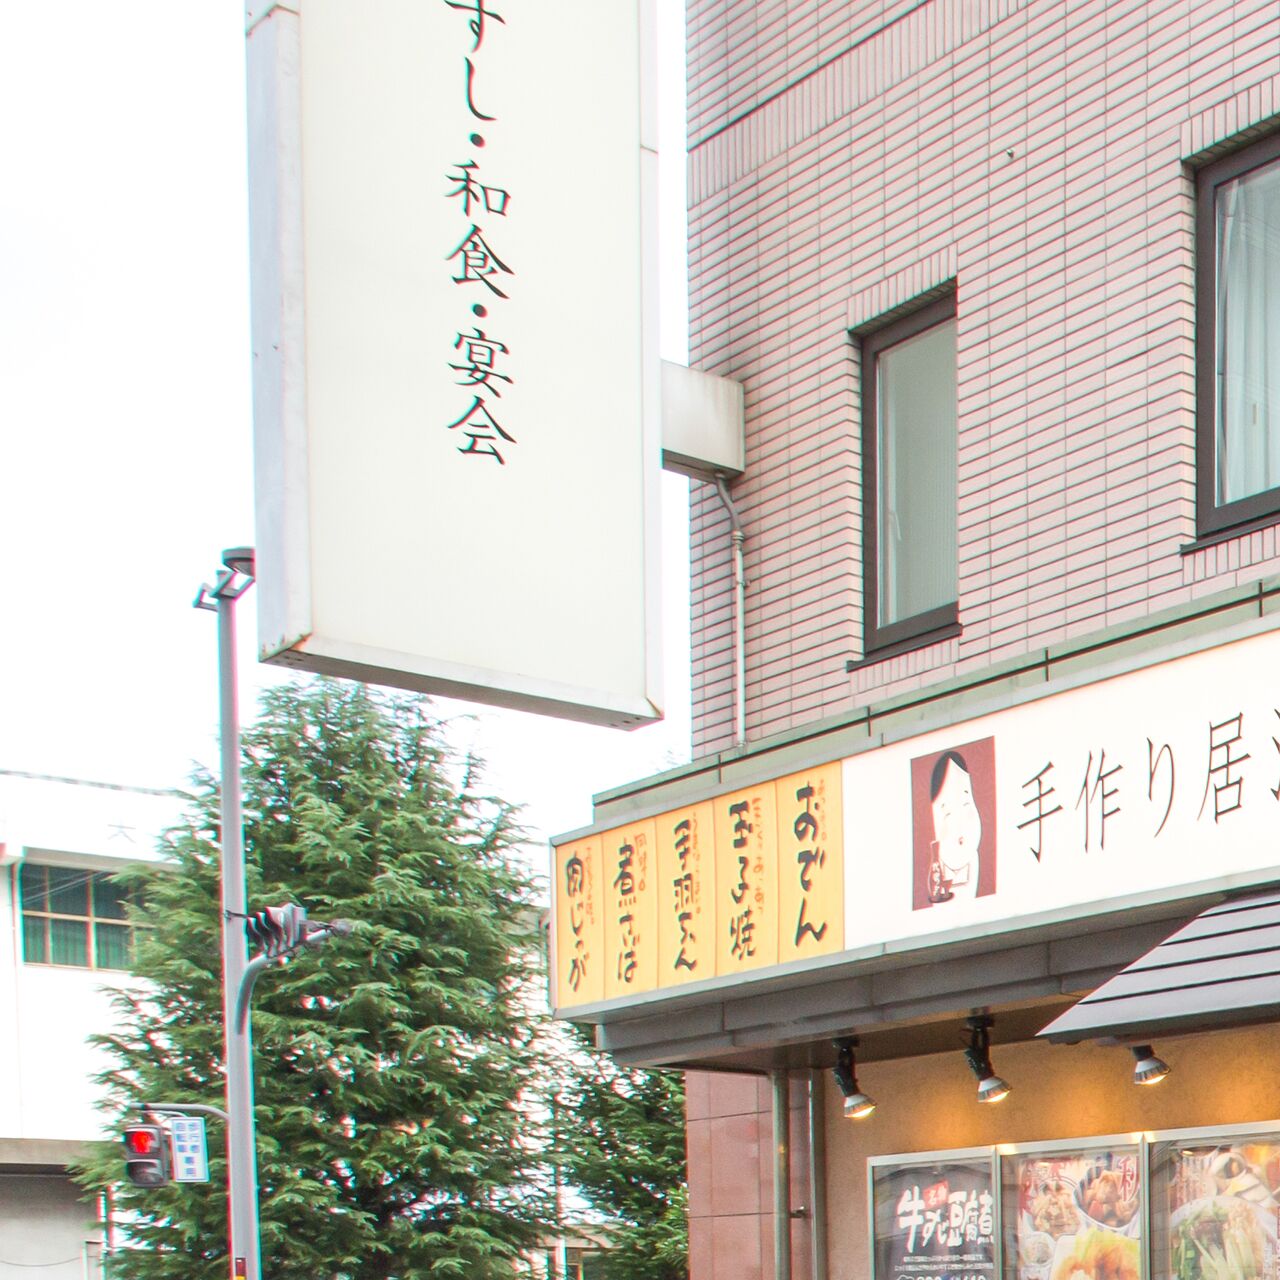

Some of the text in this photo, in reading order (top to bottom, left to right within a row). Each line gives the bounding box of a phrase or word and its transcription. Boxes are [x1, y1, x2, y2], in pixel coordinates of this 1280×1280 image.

[566, 848, 592, 993] 肉じゃが
[729, 799, 757, 962] 玉子焼
[793, 780, 829, 949] おでん
